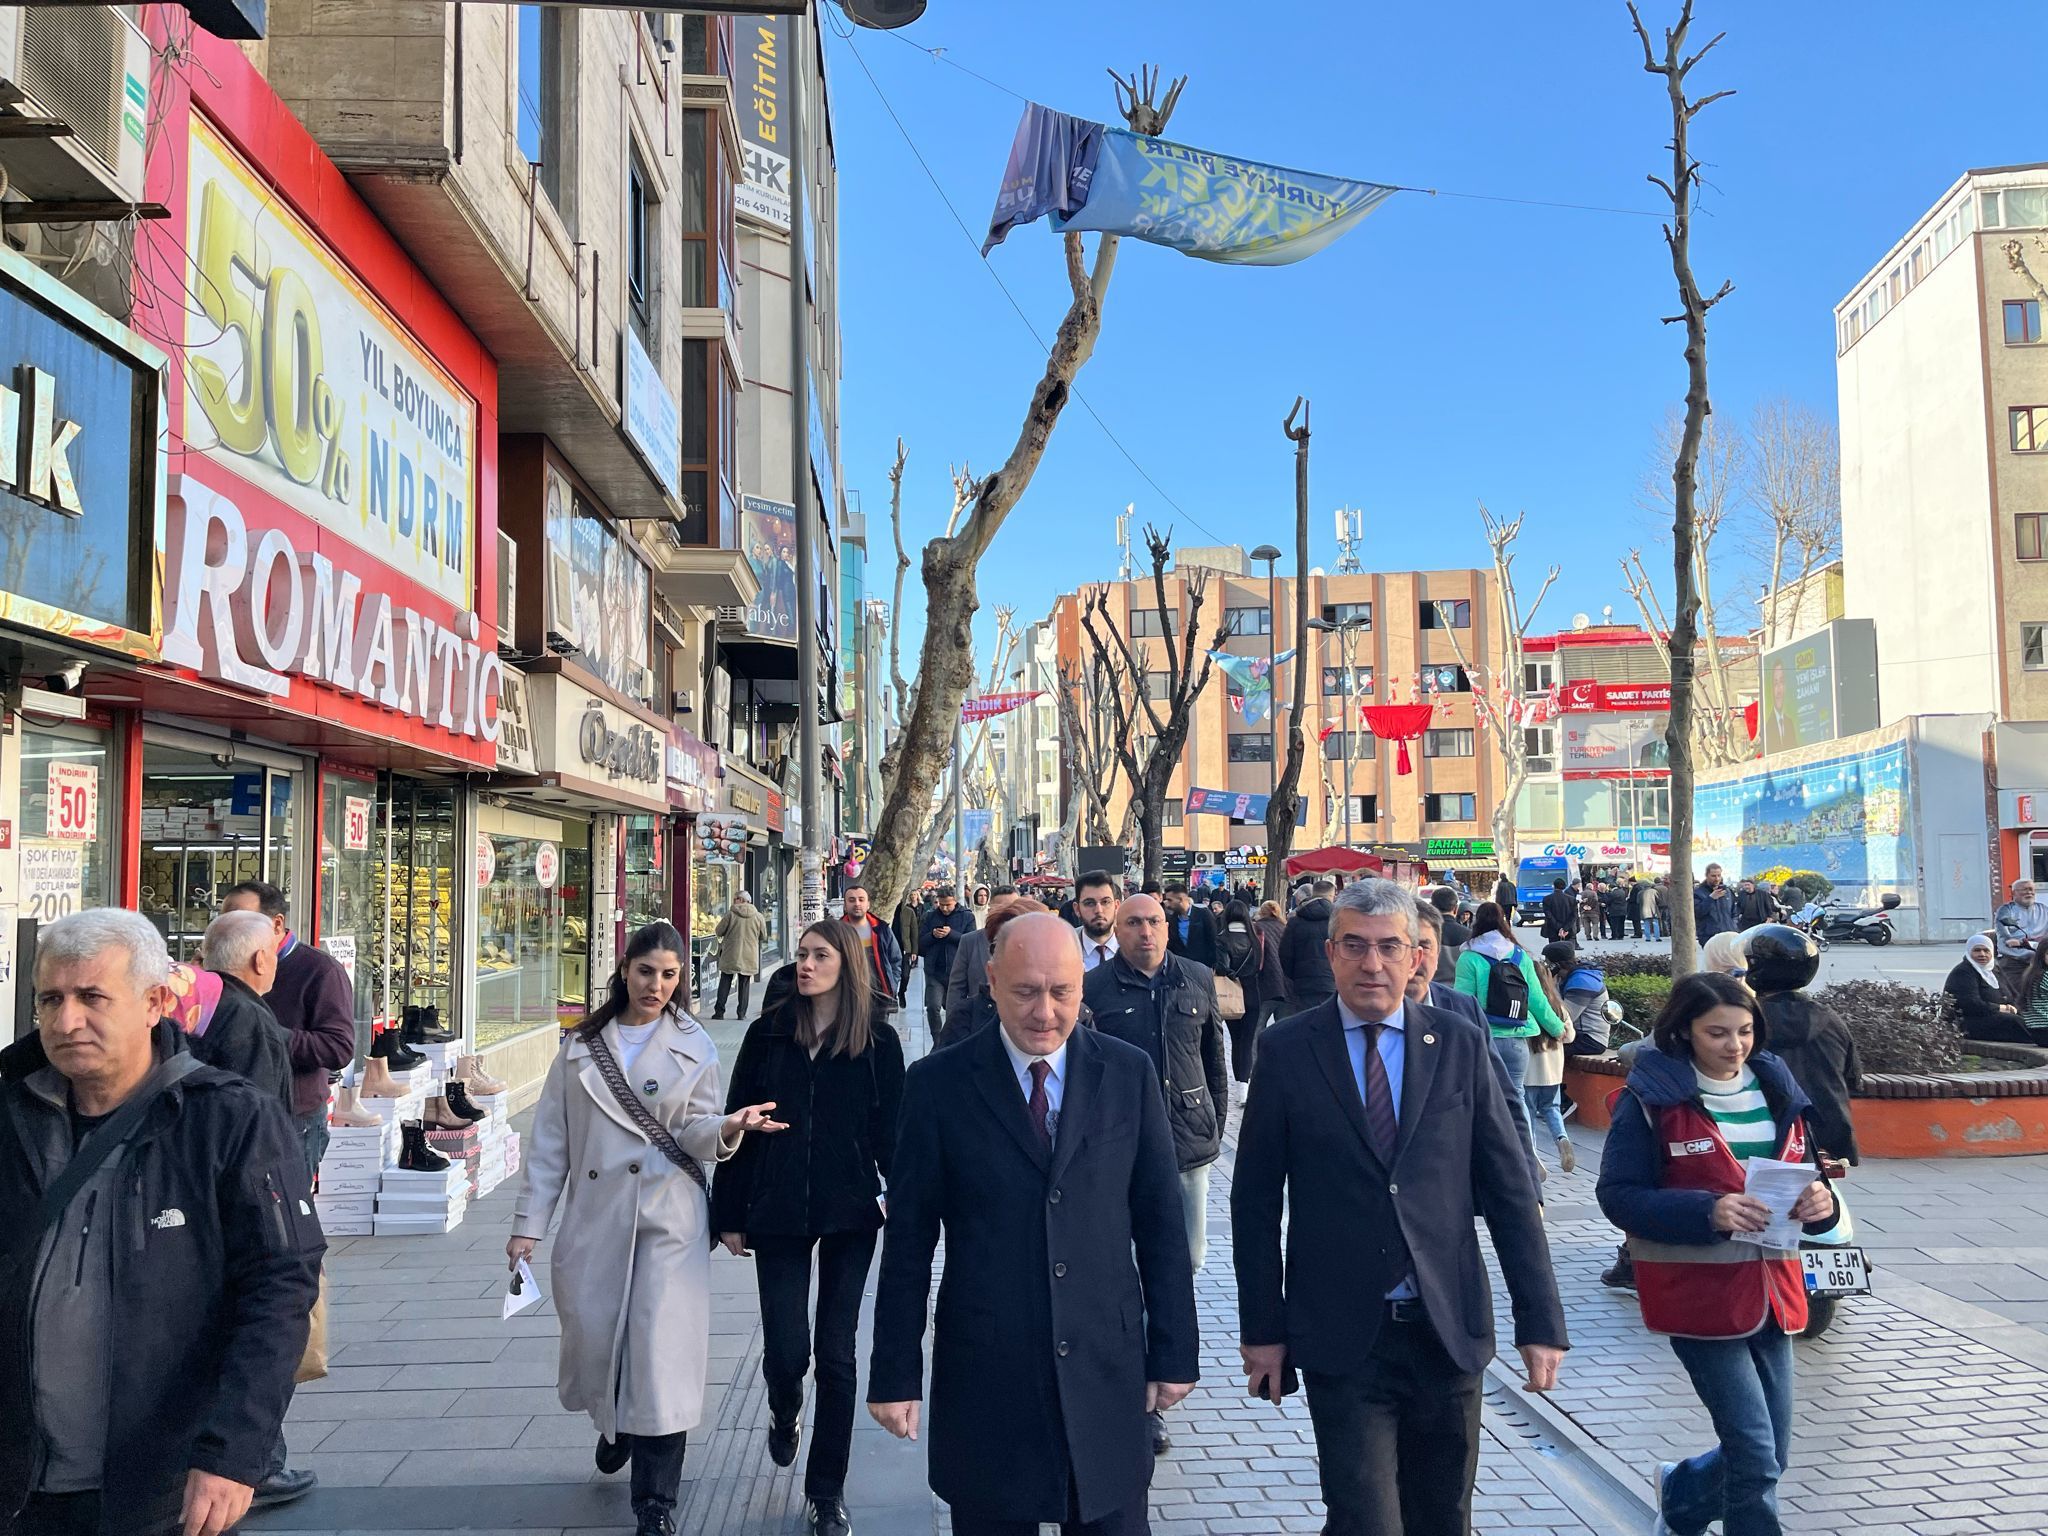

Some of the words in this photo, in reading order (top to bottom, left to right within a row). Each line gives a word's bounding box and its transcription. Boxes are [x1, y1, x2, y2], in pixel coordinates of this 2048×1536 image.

[752, 27, 777, 144] EĞİTİM
[735, 194, 751, 207] 216
[752, 201, 770, 216] 491
[772, 208, 781, 220] 11
[359, 329, 389, 402] YIL
[393, 363, 463, 467] BOYUNCA
[747, 499, 771, 513] yeşim
[1606, 691, 1639, 700] SAADET
[58, 767, 88, 779] İNDİRİM
[60, 785, 87, 829] 50
[57, 829, 87, 840] İNDİRİM
[351, 812, 363, 841] 50
[1428, 839, 1466, 849] BAHAR
[1544, 843, 1587, 859] Güleç
[1600, 845, 1627, 855] Bebe
[27, 849, 49, 865] ŞOK
[51, 846, 78, 862] FİYAT
[1224, 856, 1247, 865] GSM
[1427, 848, 1468, 857] KURUYEMİŞ
[35, 881, 65, 892] BOTLAR
[29, 892, 72, 923] 200
[1686, 1139, 1713, 1154] CHP
[1806, 1252, 1823, 1269] 34
[1834, 1251, 1860, 1269] EJM
[1828, 1271, 1854, 1287] 060
